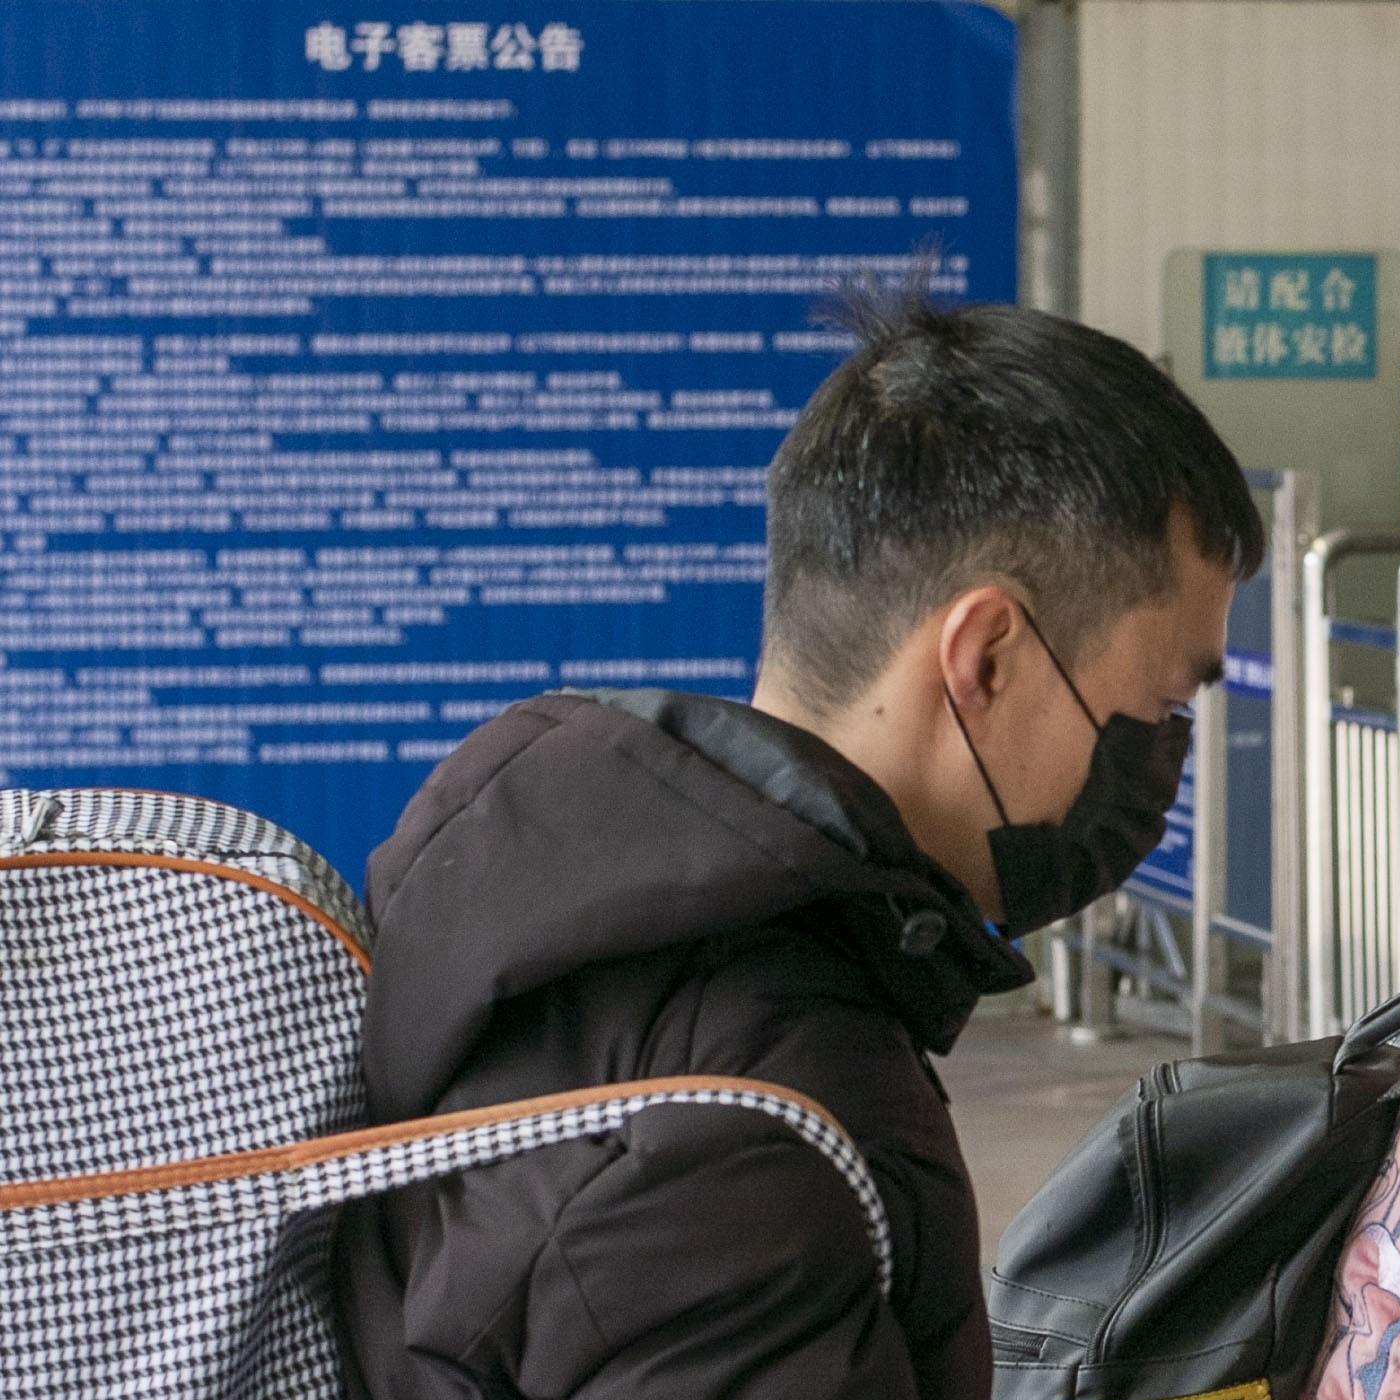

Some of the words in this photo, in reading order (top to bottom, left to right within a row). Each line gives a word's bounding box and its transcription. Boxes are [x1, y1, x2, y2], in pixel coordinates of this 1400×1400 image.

[305, 21, 584, 72] 电子客票公告
